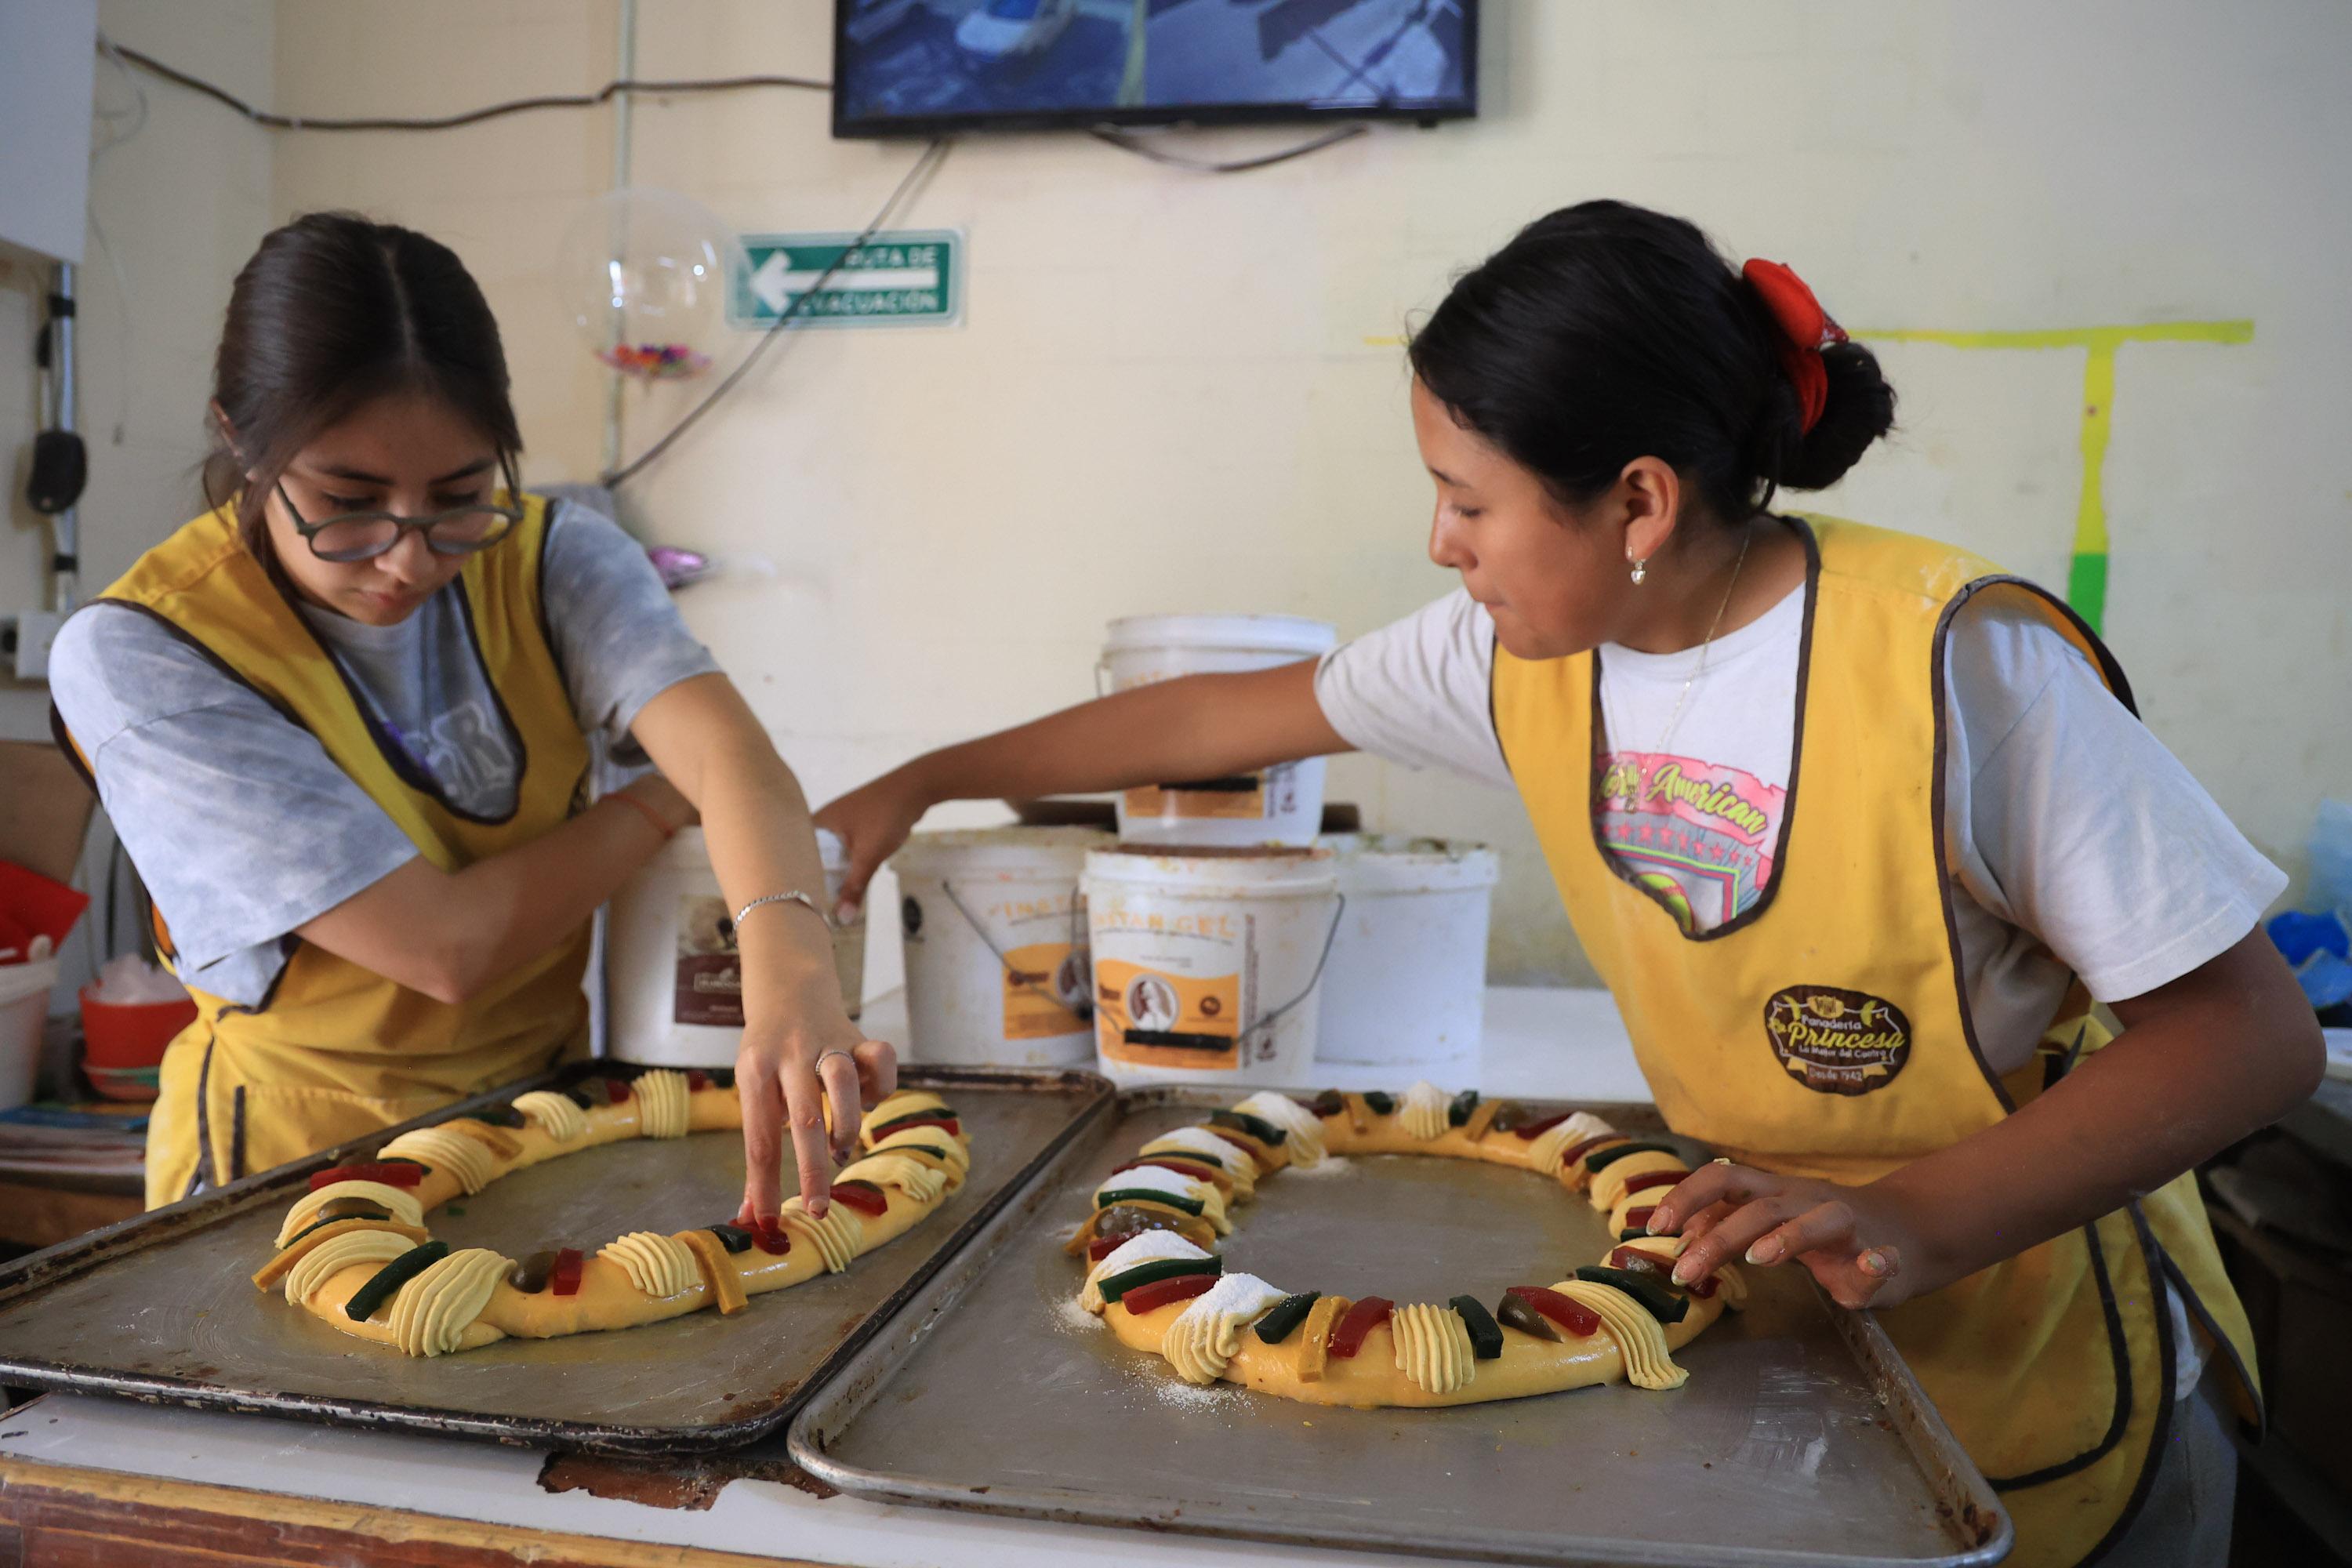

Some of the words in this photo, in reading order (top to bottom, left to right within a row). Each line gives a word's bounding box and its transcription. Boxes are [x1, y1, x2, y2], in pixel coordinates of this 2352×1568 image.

[907, 245, 938, 266] DE
[1645, 763, 1768, 836] American
[1788, 1021, 1906, 1049] Princesa
